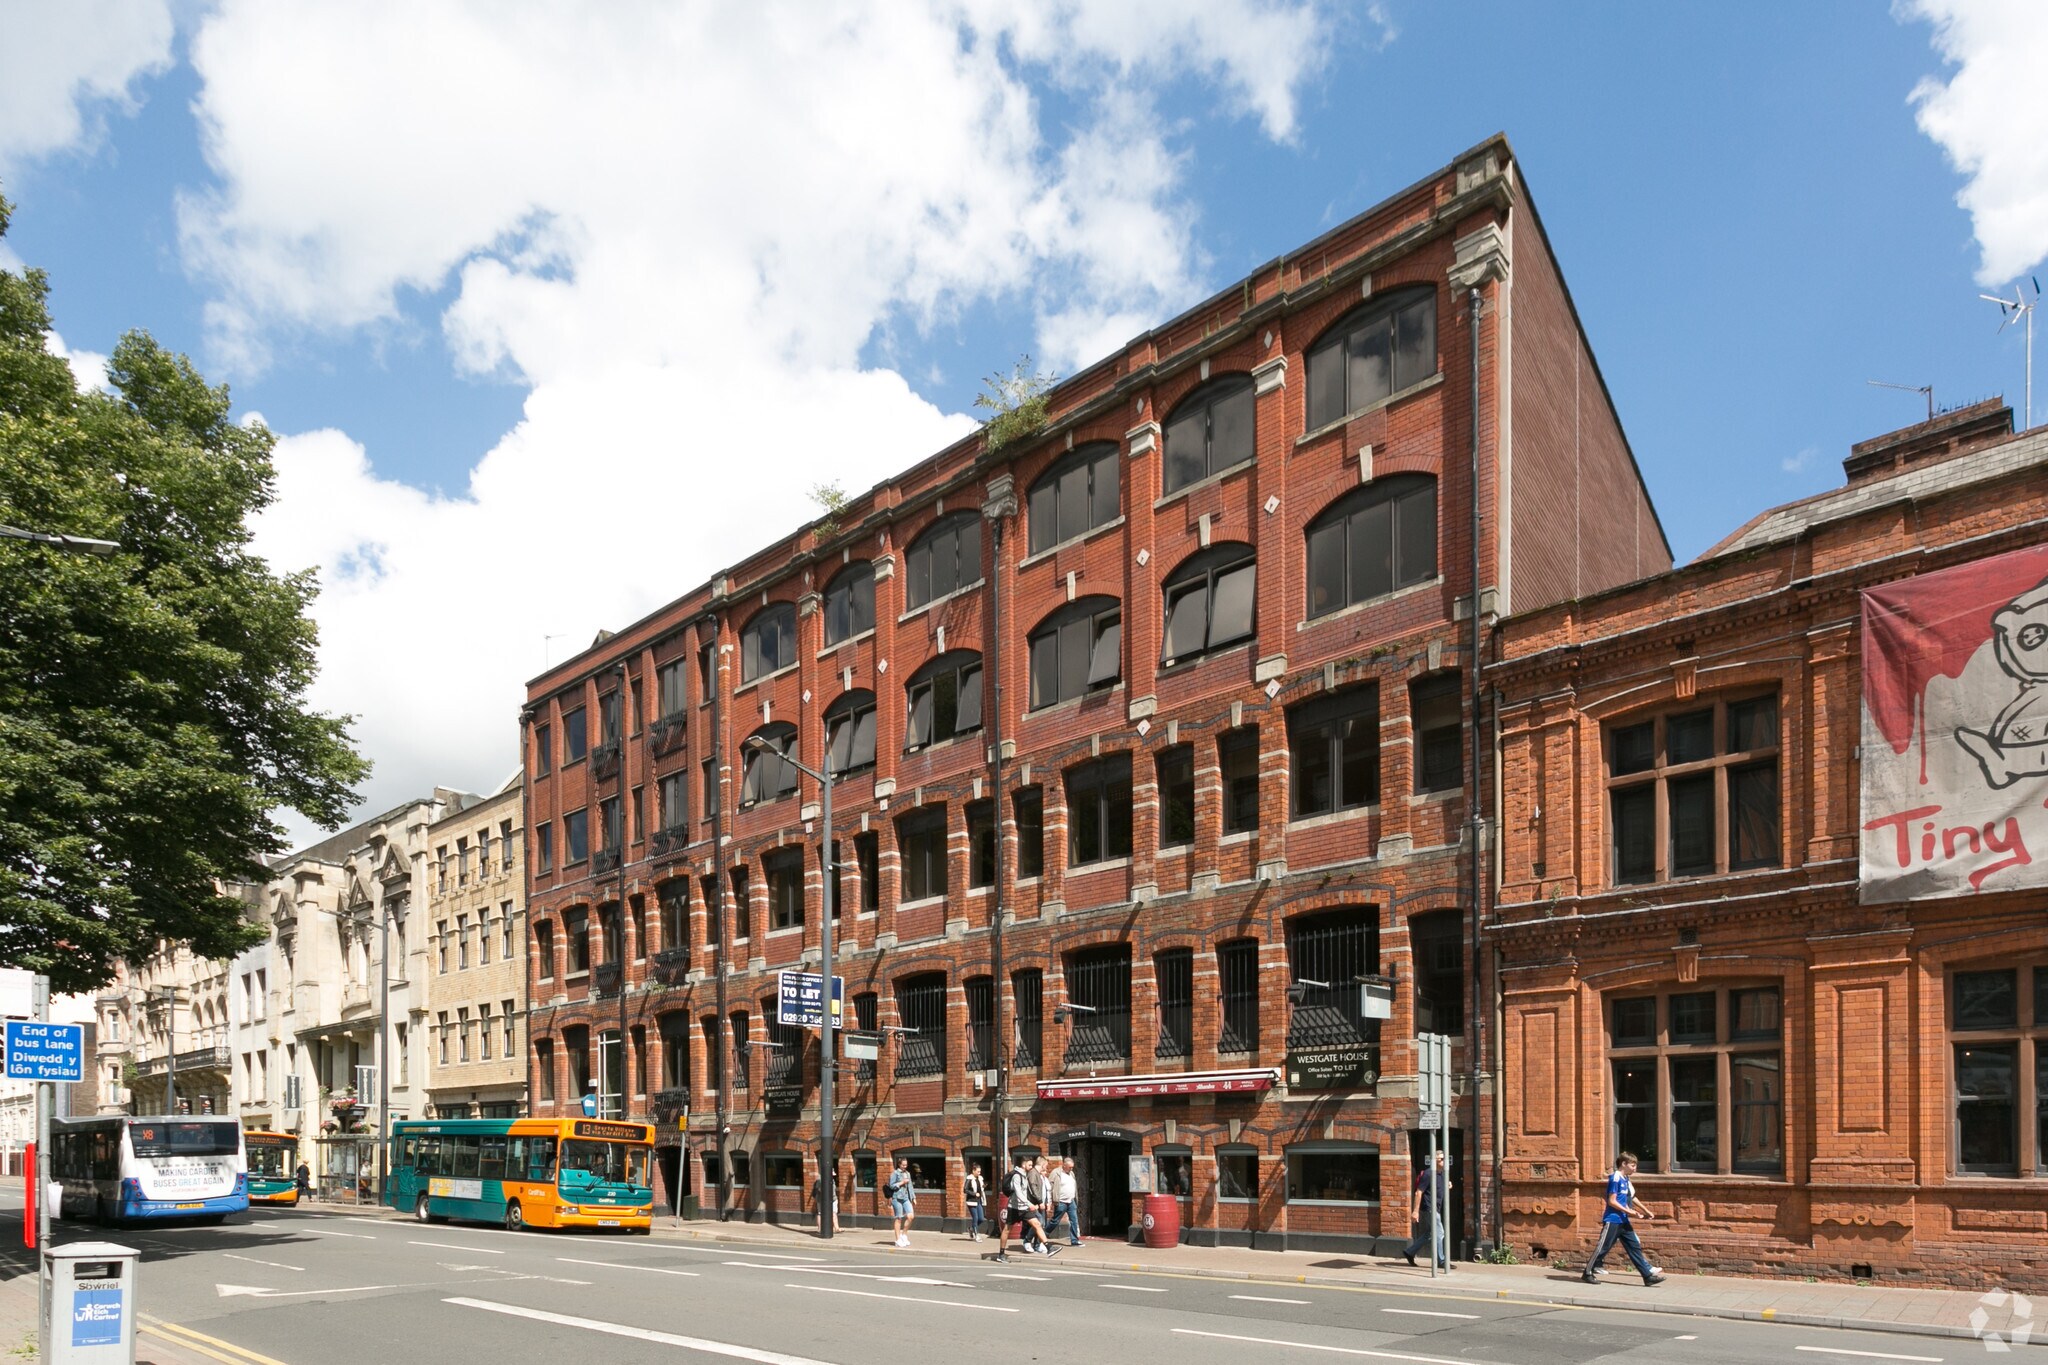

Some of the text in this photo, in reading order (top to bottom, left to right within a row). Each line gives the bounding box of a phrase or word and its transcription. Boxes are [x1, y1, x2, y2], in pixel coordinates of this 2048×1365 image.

[1863, 805, 2032, 890] Tiny
[783, 986, 820, 1000] TO LET
[783, 1013, 808, 1023] 02920
[22, 1026, 68, 1037] End of
[15, 1038, 74, 1050] bus lane
[13, 1052, 76, 1066] Diwedd y
[1297, 1052, 1369, 1064] WESTGATE HOUSE
[10, 1064, 78, 1076] lôn fysiau
[582, 1124, 590, 1134] 13
[158, 1166, 218, 1177] MAKING CARDIFF
[154, 1176, 224, 1188] BUSES GREAT AGAIN
[78, 1282, 118, 1290] Sbwriel
